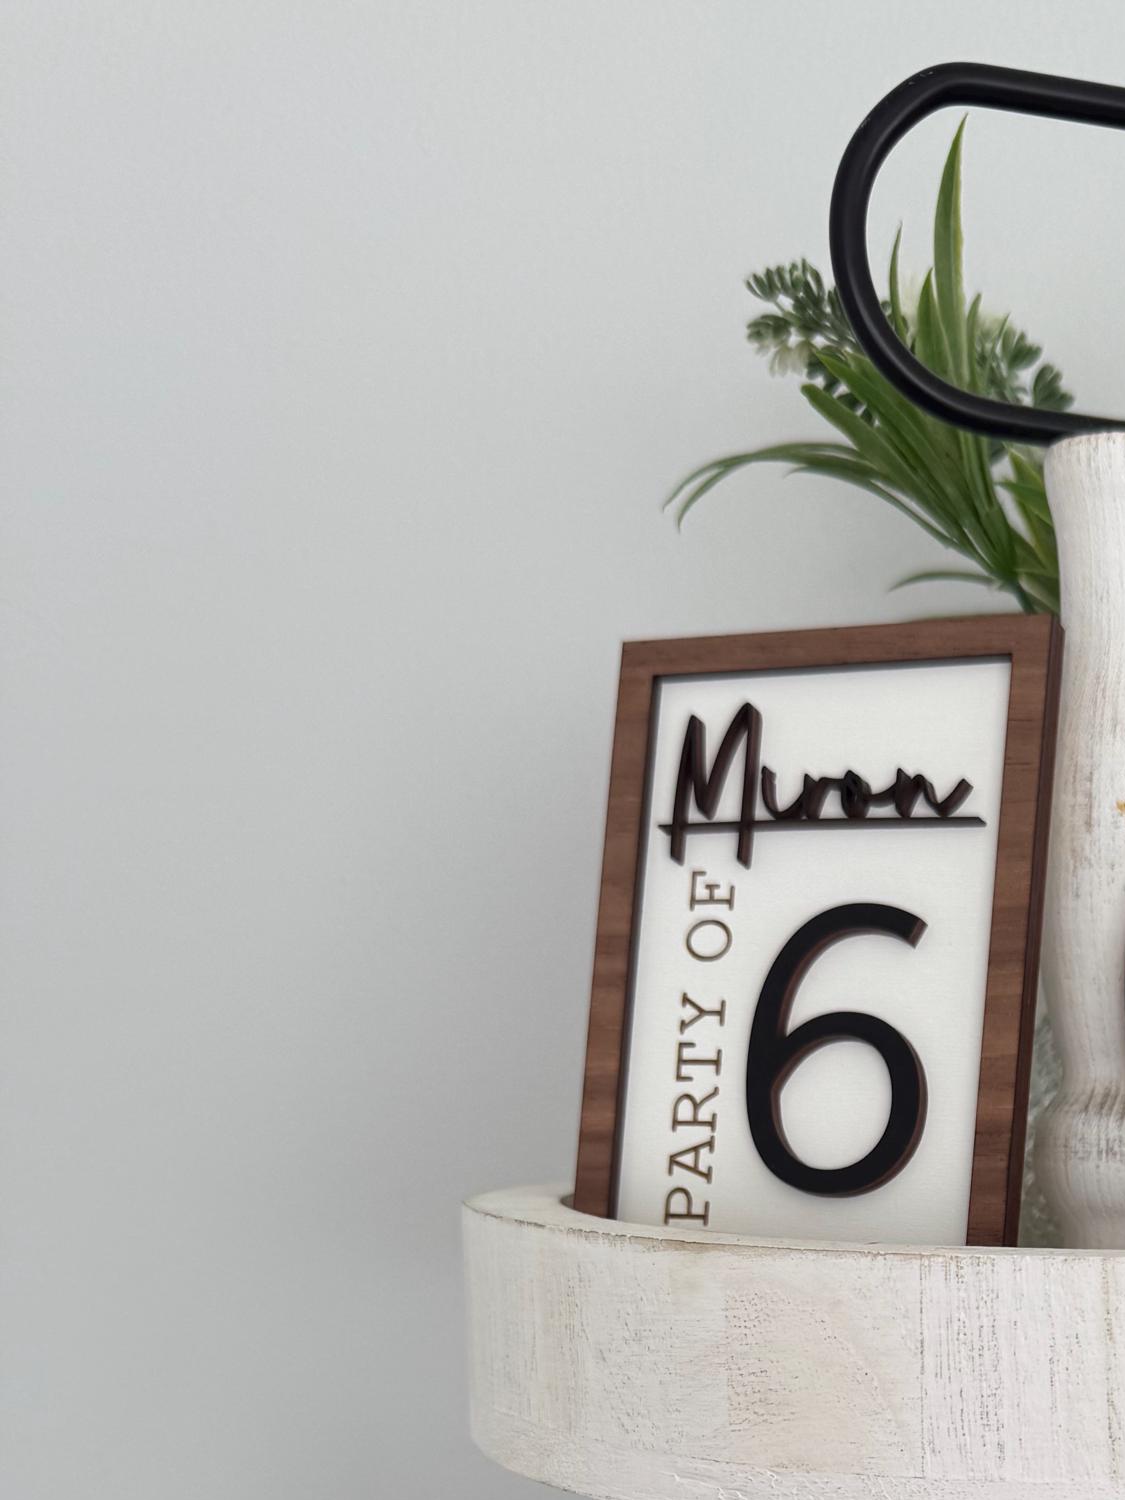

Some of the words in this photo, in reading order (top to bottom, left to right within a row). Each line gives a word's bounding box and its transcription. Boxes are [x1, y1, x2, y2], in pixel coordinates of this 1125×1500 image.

[685, 870, 735, 962] OF
[664, 992, 726, 1226] PARTY
[745, 902, 928, 1198] 6
